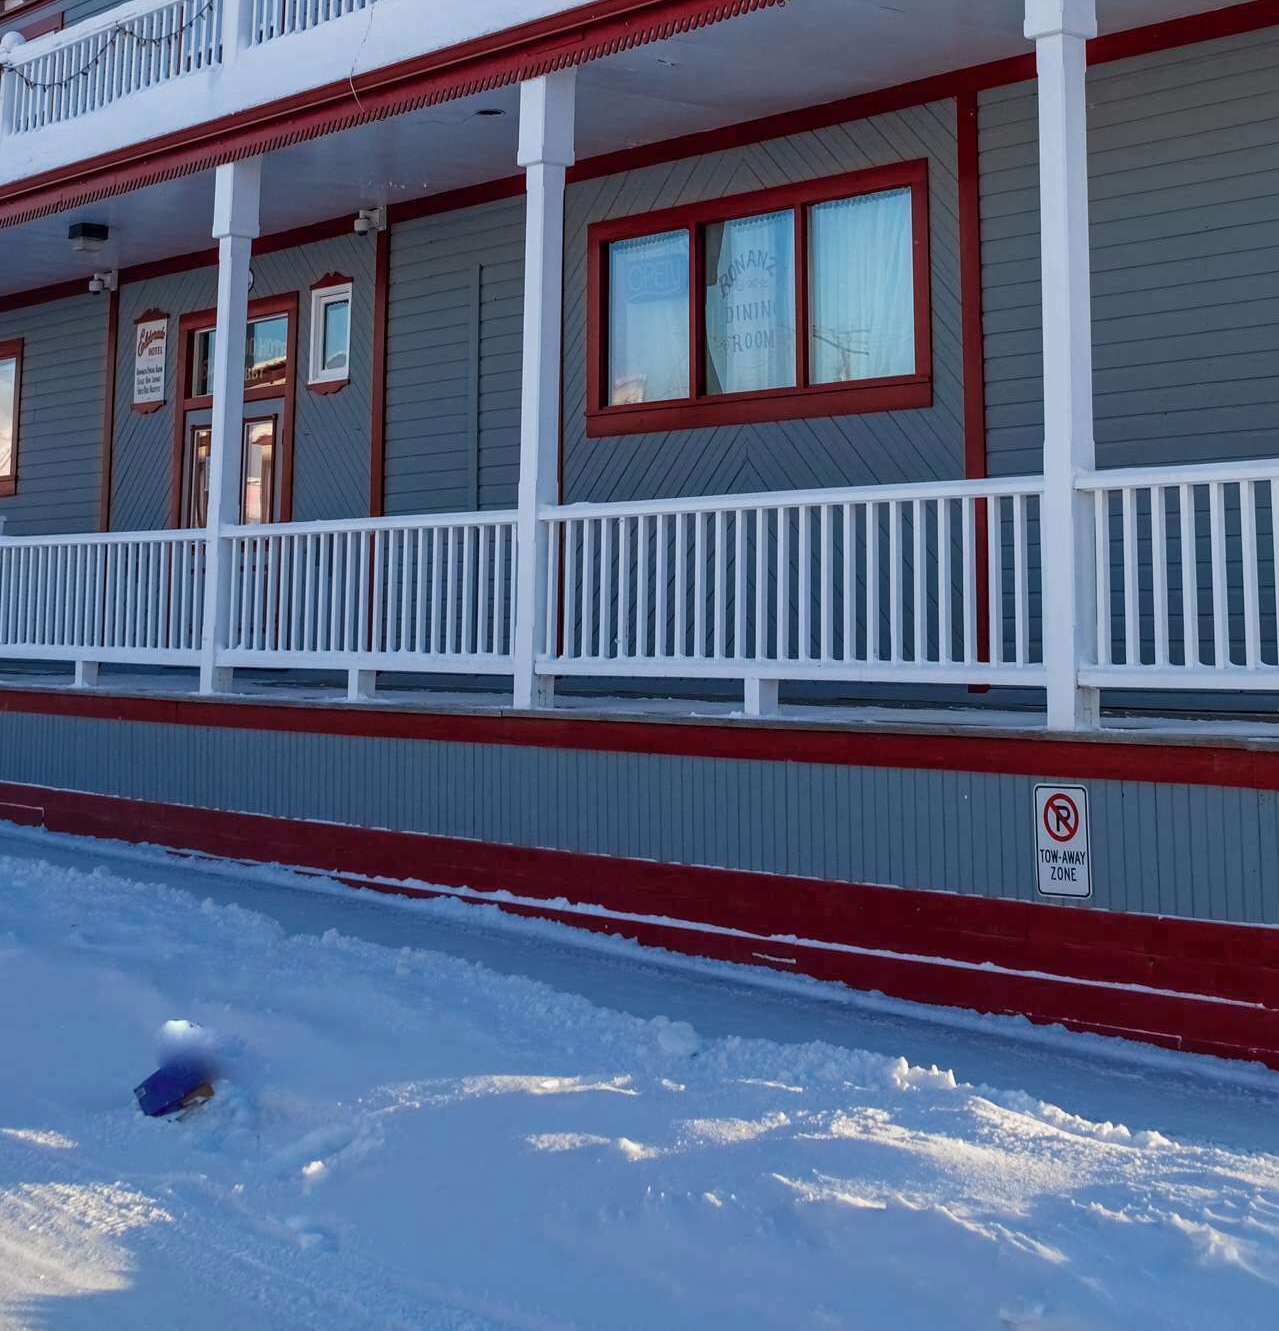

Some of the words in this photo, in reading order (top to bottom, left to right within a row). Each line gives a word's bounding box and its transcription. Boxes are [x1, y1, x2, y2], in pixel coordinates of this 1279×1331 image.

[719, 249, 777, 300] BONANZ
[732, 329, 776, 353] ROOM
[1039, 849, 1086, 866] TOW-AWAY
[1050, 866, 1077, 882] ZONE
